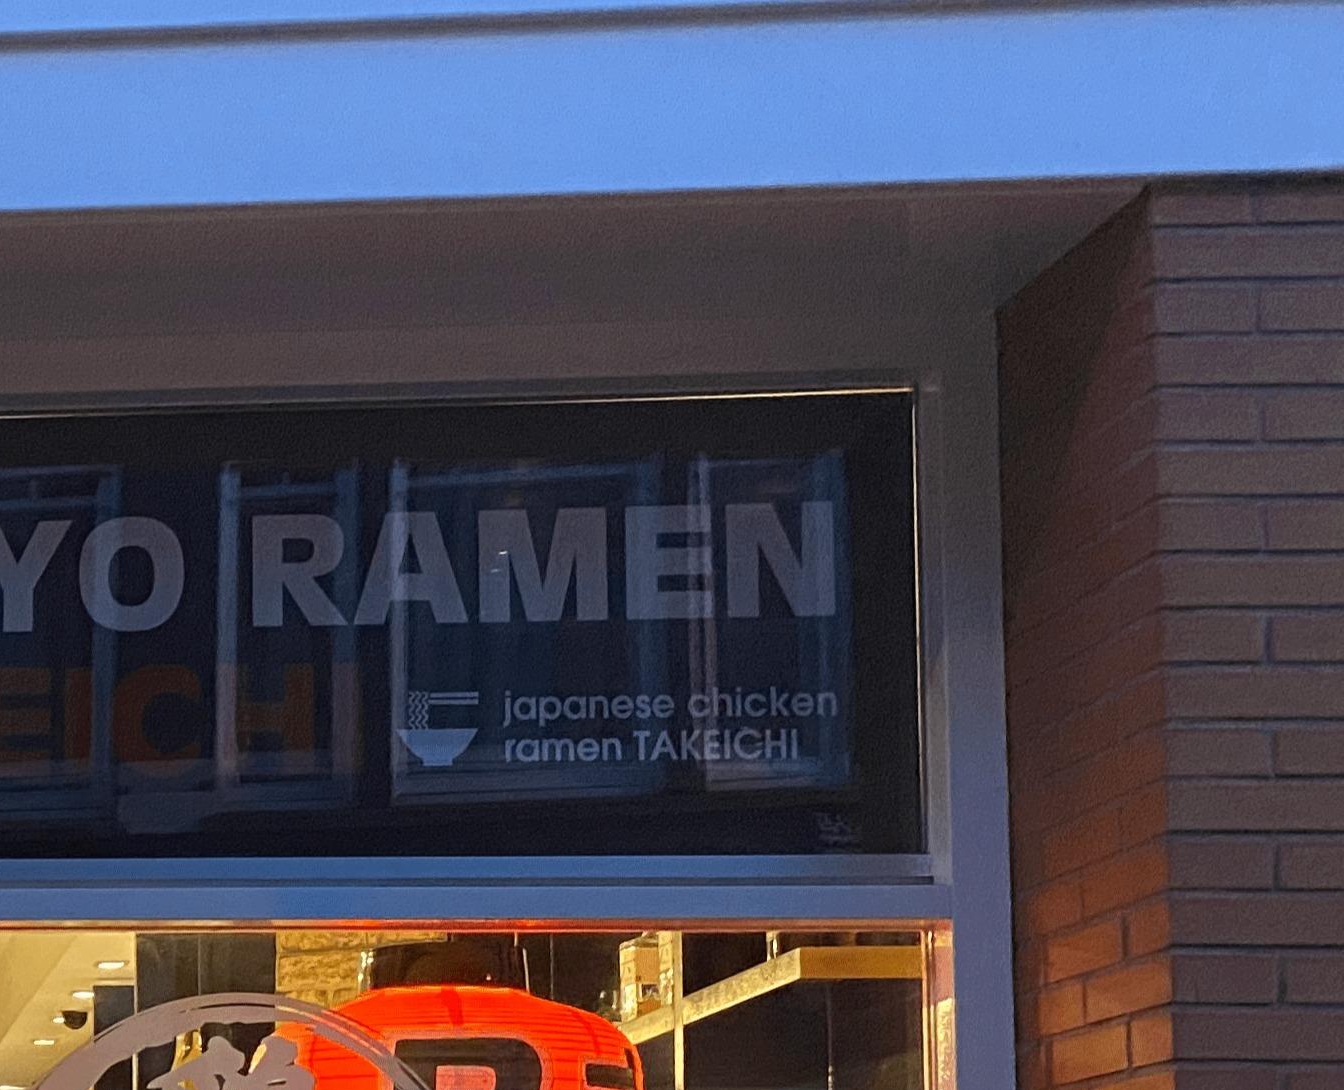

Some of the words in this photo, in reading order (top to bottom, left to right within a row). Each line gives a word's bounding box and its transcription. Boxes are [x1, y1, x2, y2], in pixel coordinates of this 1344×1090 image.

[251, 501, 837, 628] RAMEN
[502, 689, 674, 727] japanese
[688, 686, 840, 717] chicken
[504, 735, 621, 763] ramen
[633, 727, 799, 763] TAKEICHI
